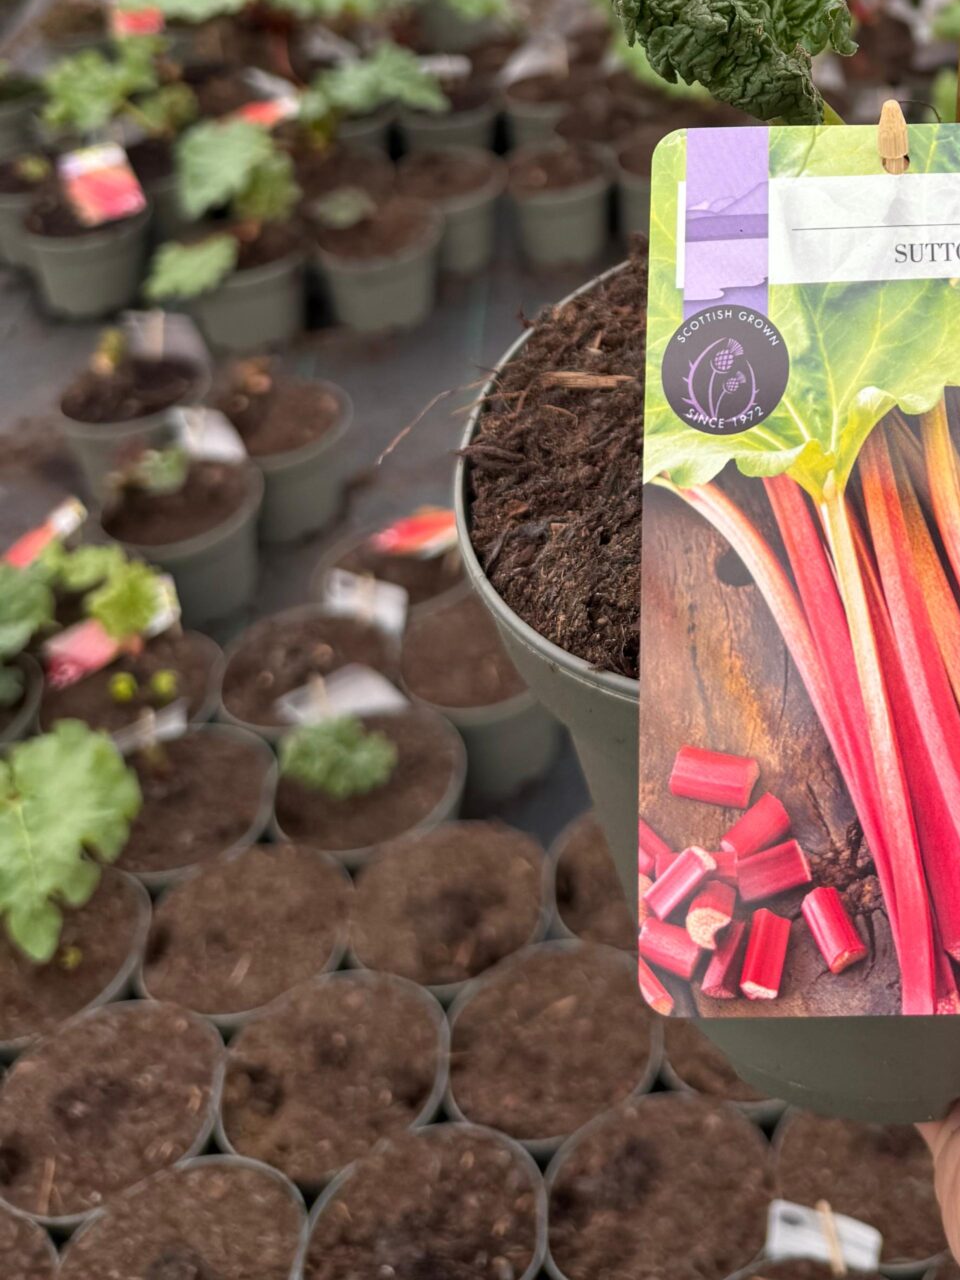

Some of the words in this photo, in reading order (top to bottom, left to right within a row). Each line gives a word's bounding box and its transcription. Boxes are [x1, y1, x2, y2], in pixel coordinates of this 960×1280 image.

[676, 309, 733, 343] SCOTTISH
[738, 311, 780, 346] GROWN
[686, 408, 725, 429] SINCE
[731, 406, 765, 427] 1972
